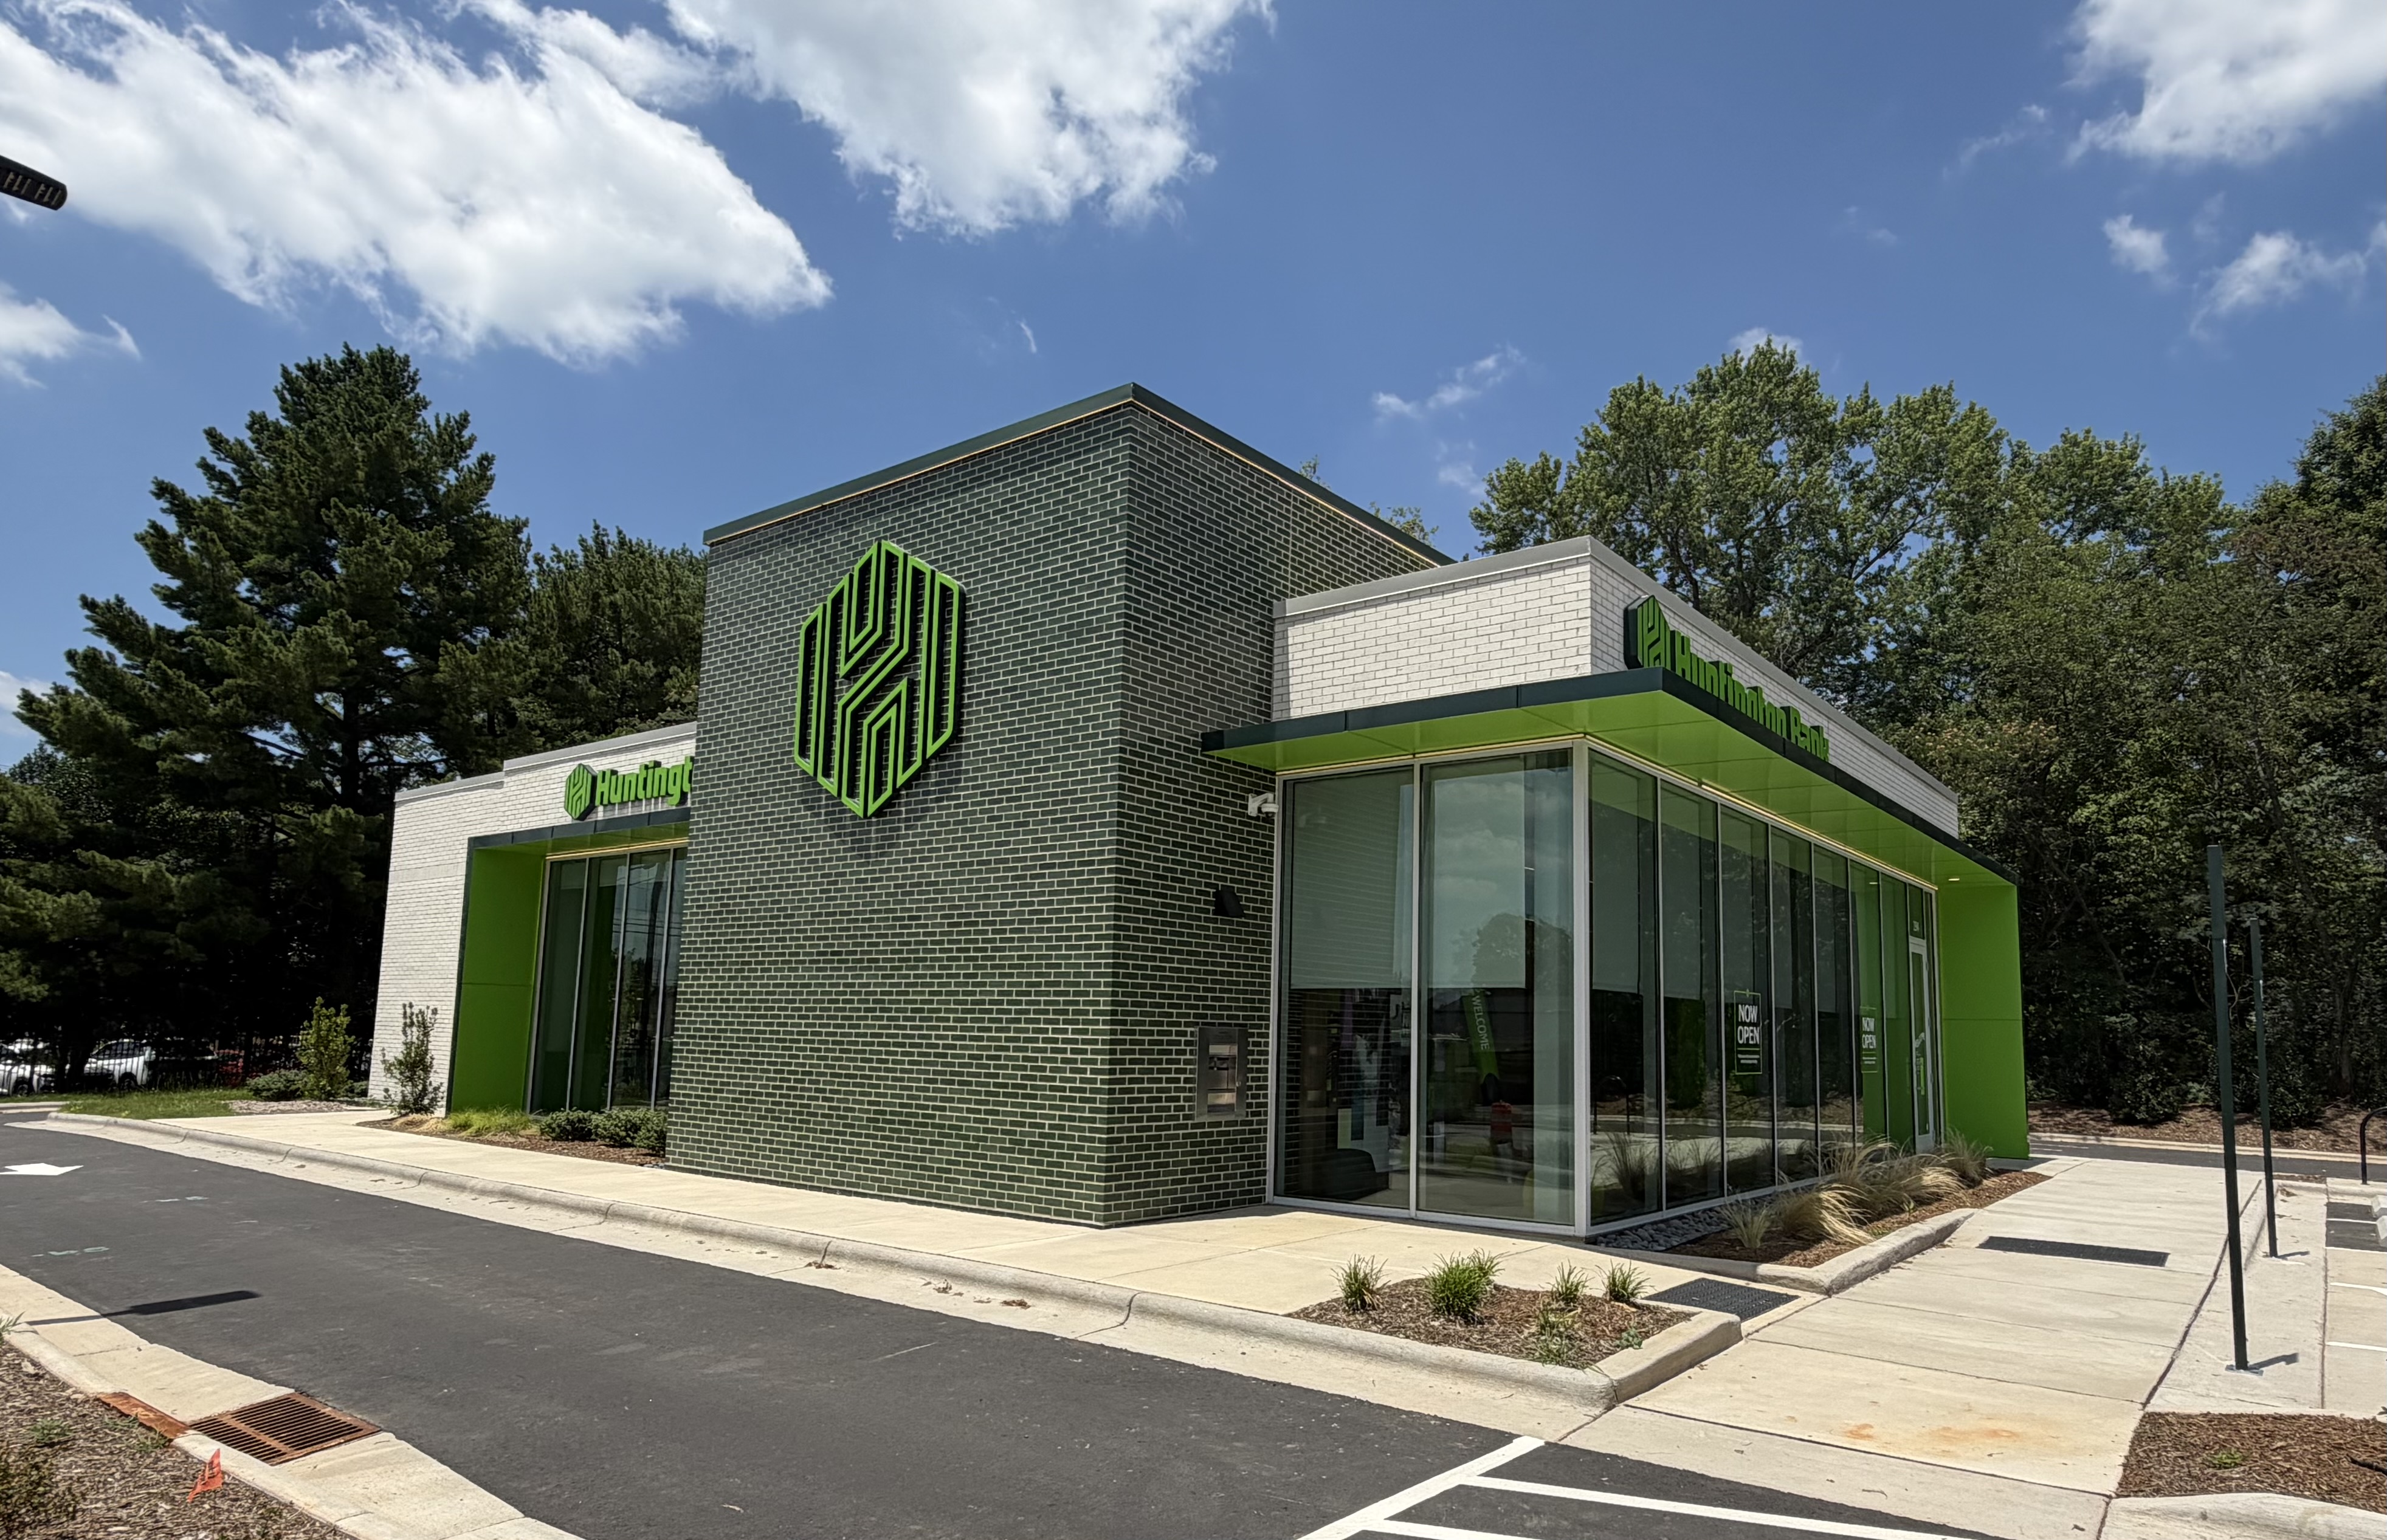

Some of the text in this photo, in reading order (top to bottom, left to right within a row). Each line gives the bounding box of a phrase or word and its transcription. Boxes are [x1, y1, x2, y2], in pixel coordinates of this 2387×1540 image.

[1790, 706, 1830, 762] Bank
[594, 755, 695, 807] Huntingt
[1471, 995, 1490, 1051] WELCOME
[1738, 1004, 1758, 1023] NOW
[1862, 1017, 1875, 1032] NOW
[1737, 1025, 1760, 1045] OPEN
[1862, 1034, 1876, 1048] OPEN
